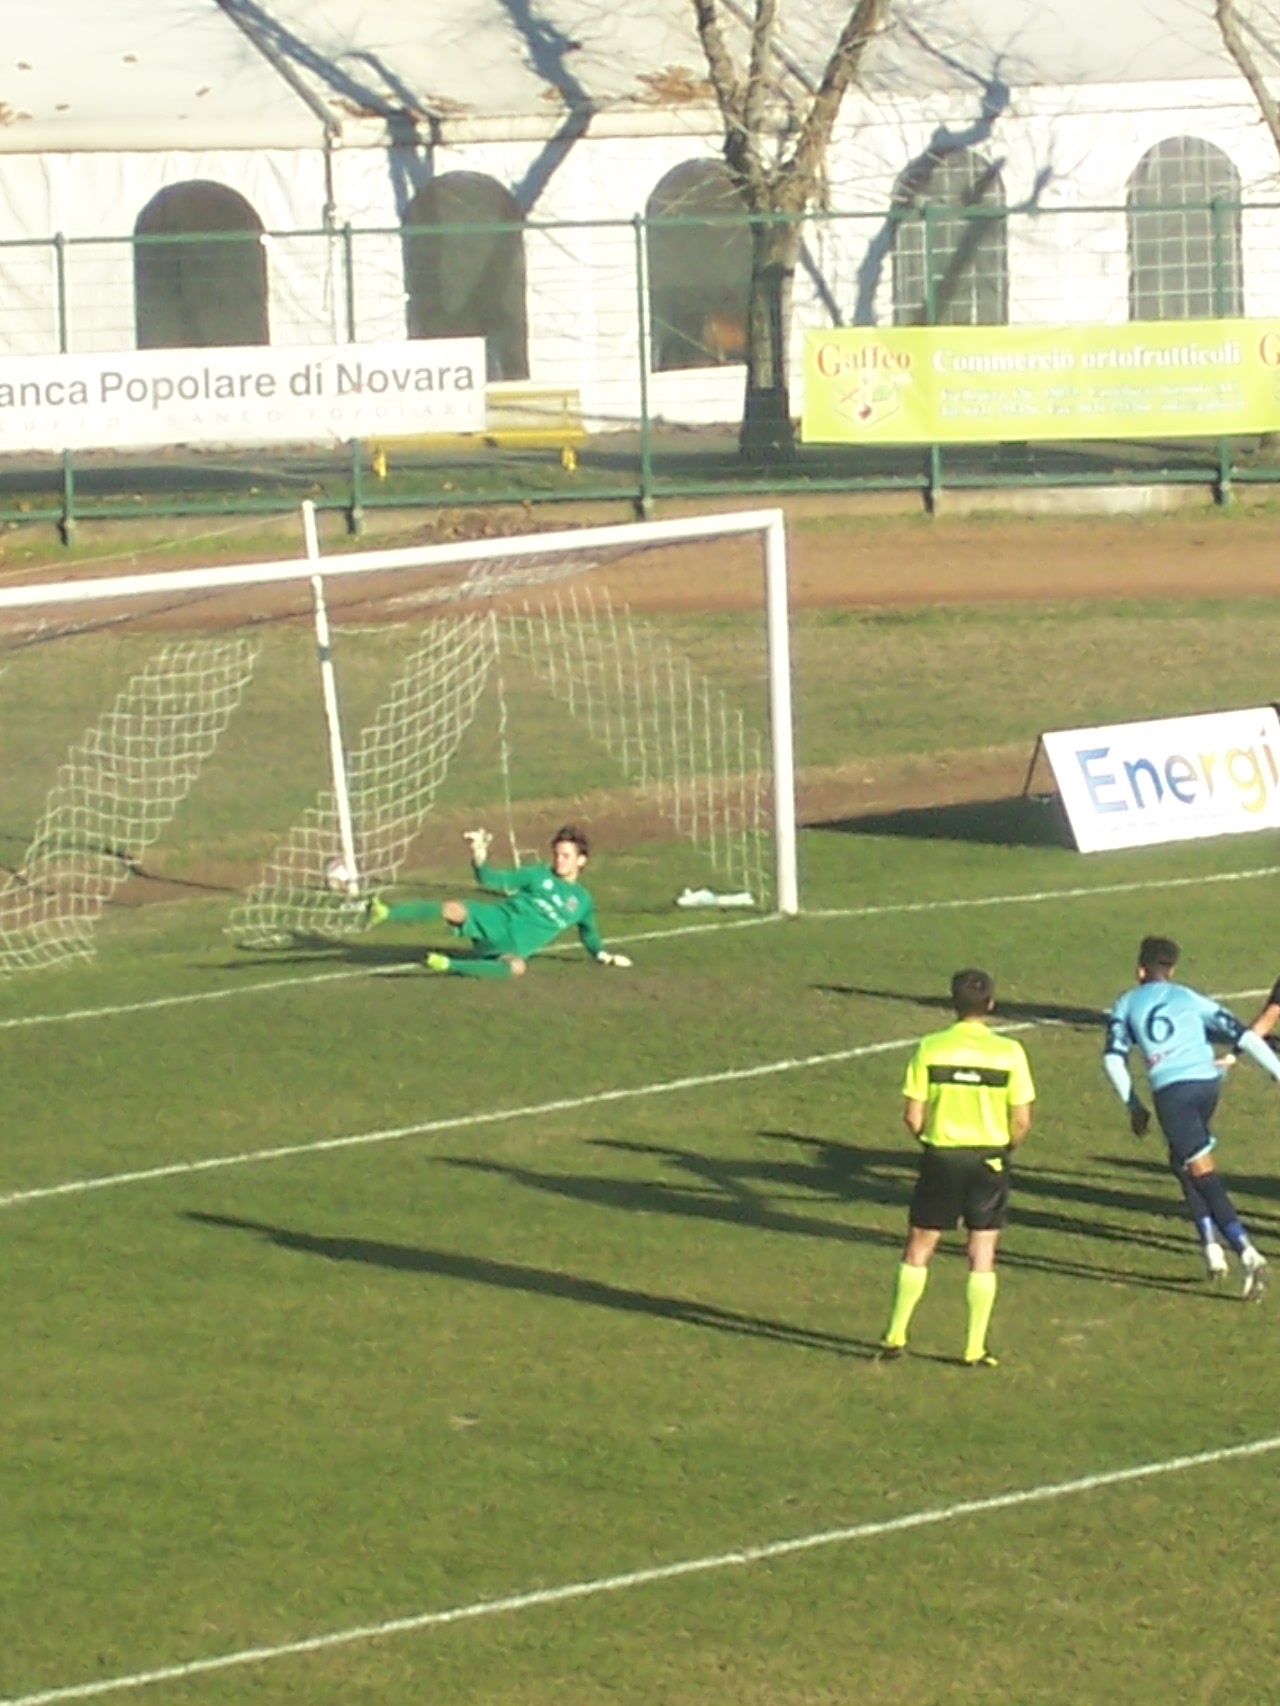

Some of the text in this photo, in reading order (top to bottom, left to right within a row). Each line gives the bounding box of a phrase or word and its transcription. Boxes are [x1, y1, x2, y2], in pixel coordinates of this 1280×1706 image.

[932, 341, 1241, 373] Commercio ortofrutticoli
[99, 366, 278, 411] Popolare
[288, 363, 323, 398] di
[335, 362, 475, 397] Novara
[1145, 1001, 1176, 1045] 6
